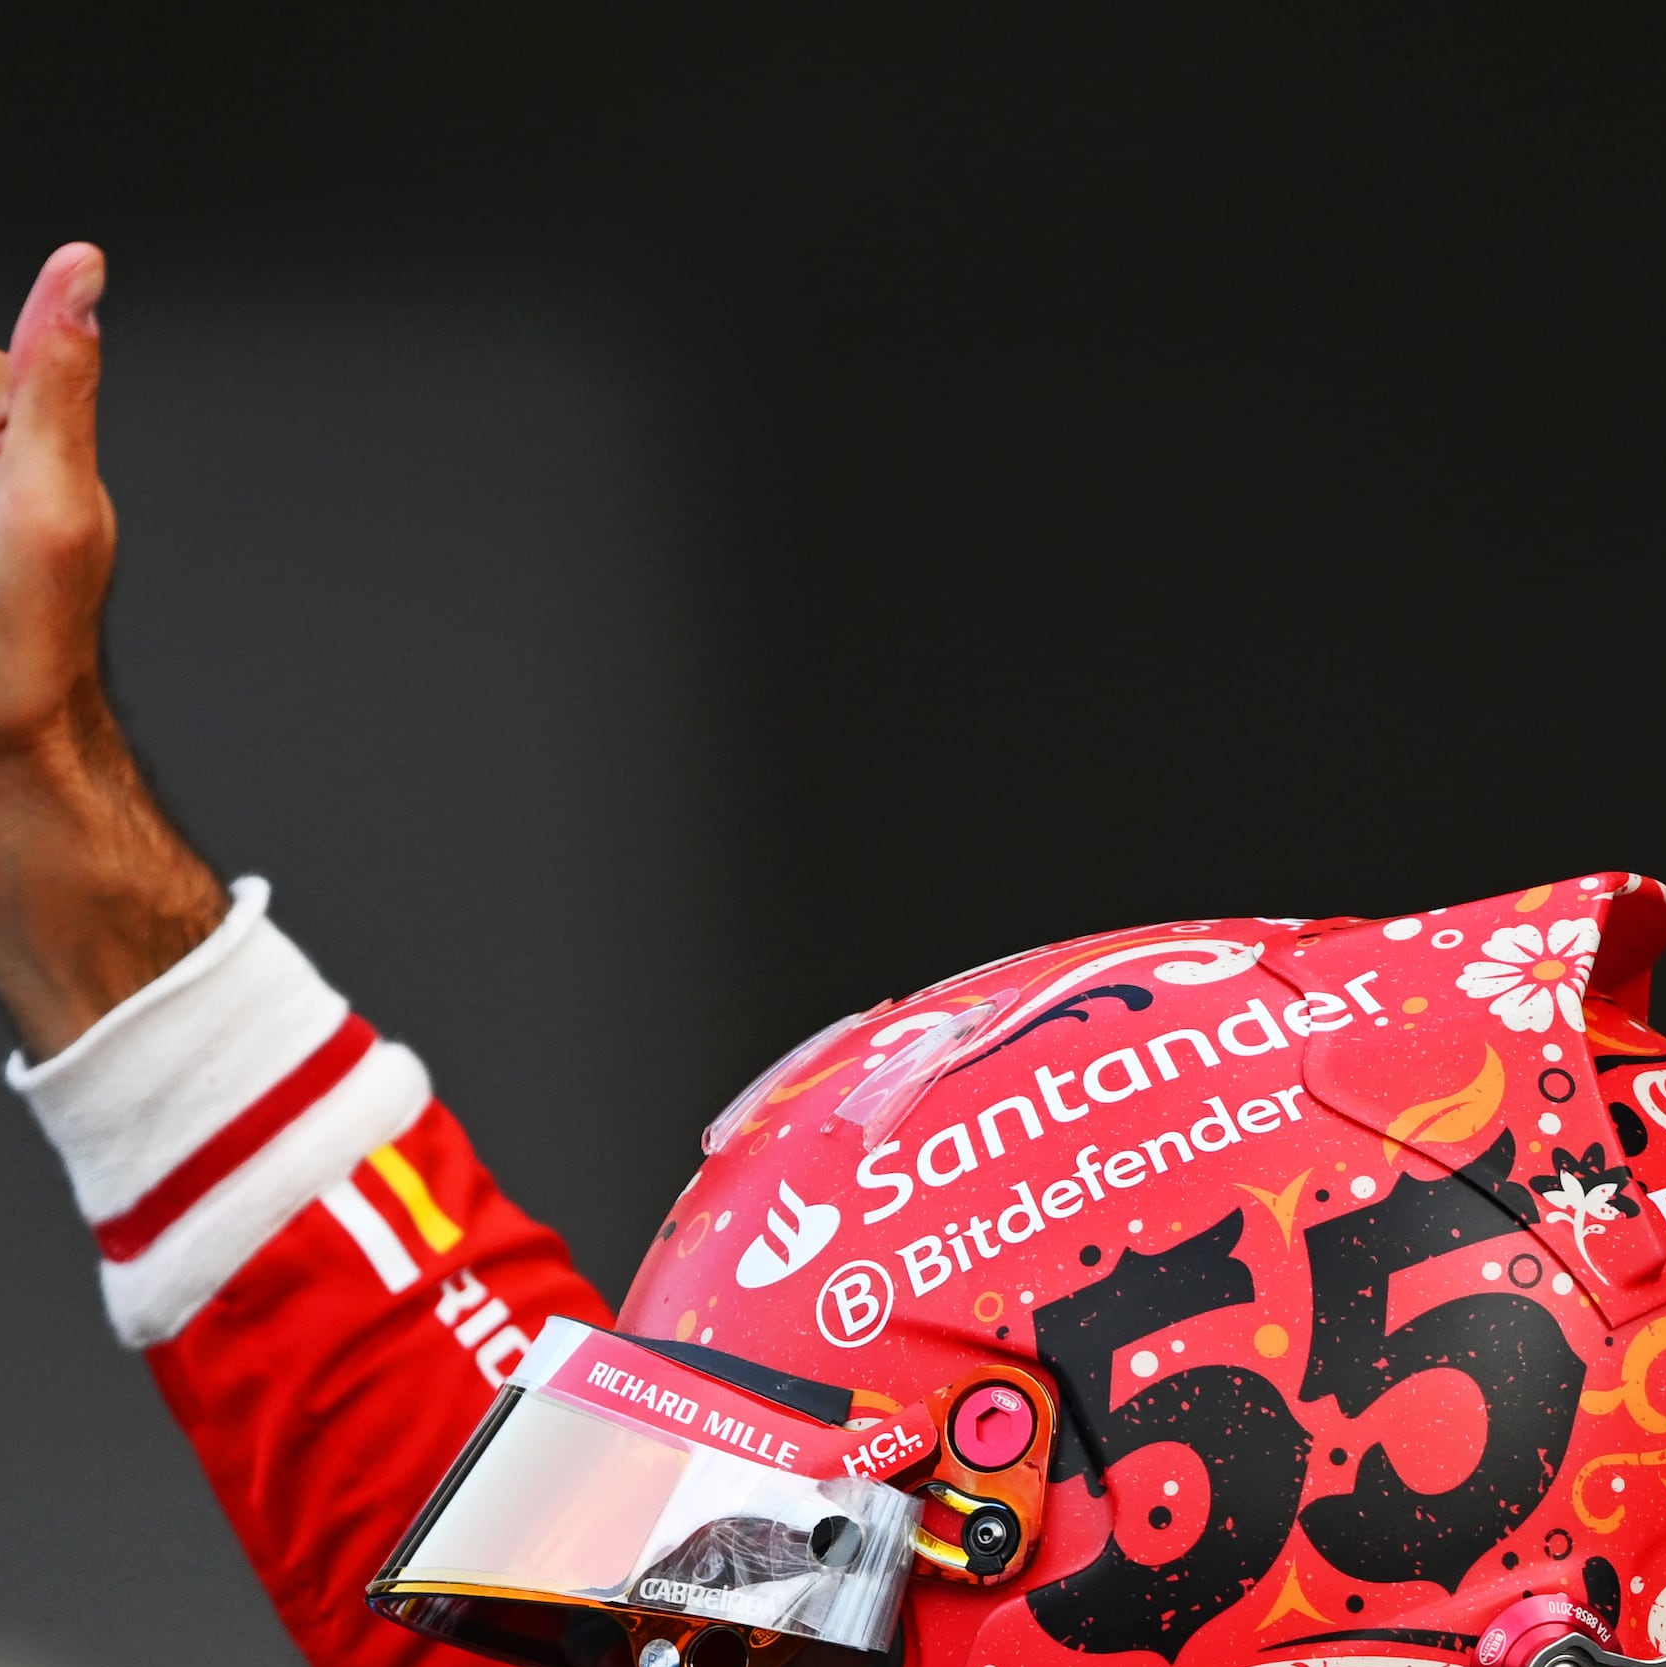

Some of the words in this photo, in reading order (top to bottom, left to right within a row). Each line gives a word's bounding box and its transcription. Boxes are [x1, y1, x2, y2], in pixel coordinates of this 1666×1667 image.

[855, 970, 1379, 1226] Santander
[897, 1084, 1304, 1299] Bitdefender
[586, 1360, 698, 1427] RICHARD
[701, 1408, 800, 1470] MILLE
[1025, 1126, 1587, 1665] 55
[842, 1424, 921, 1477] HCL
[861, 1440, 923, 1479] oftware
[1548, 1600, 1599, 1629] 8858-2010
[1596, 1625, 1612, 1643] FIA
